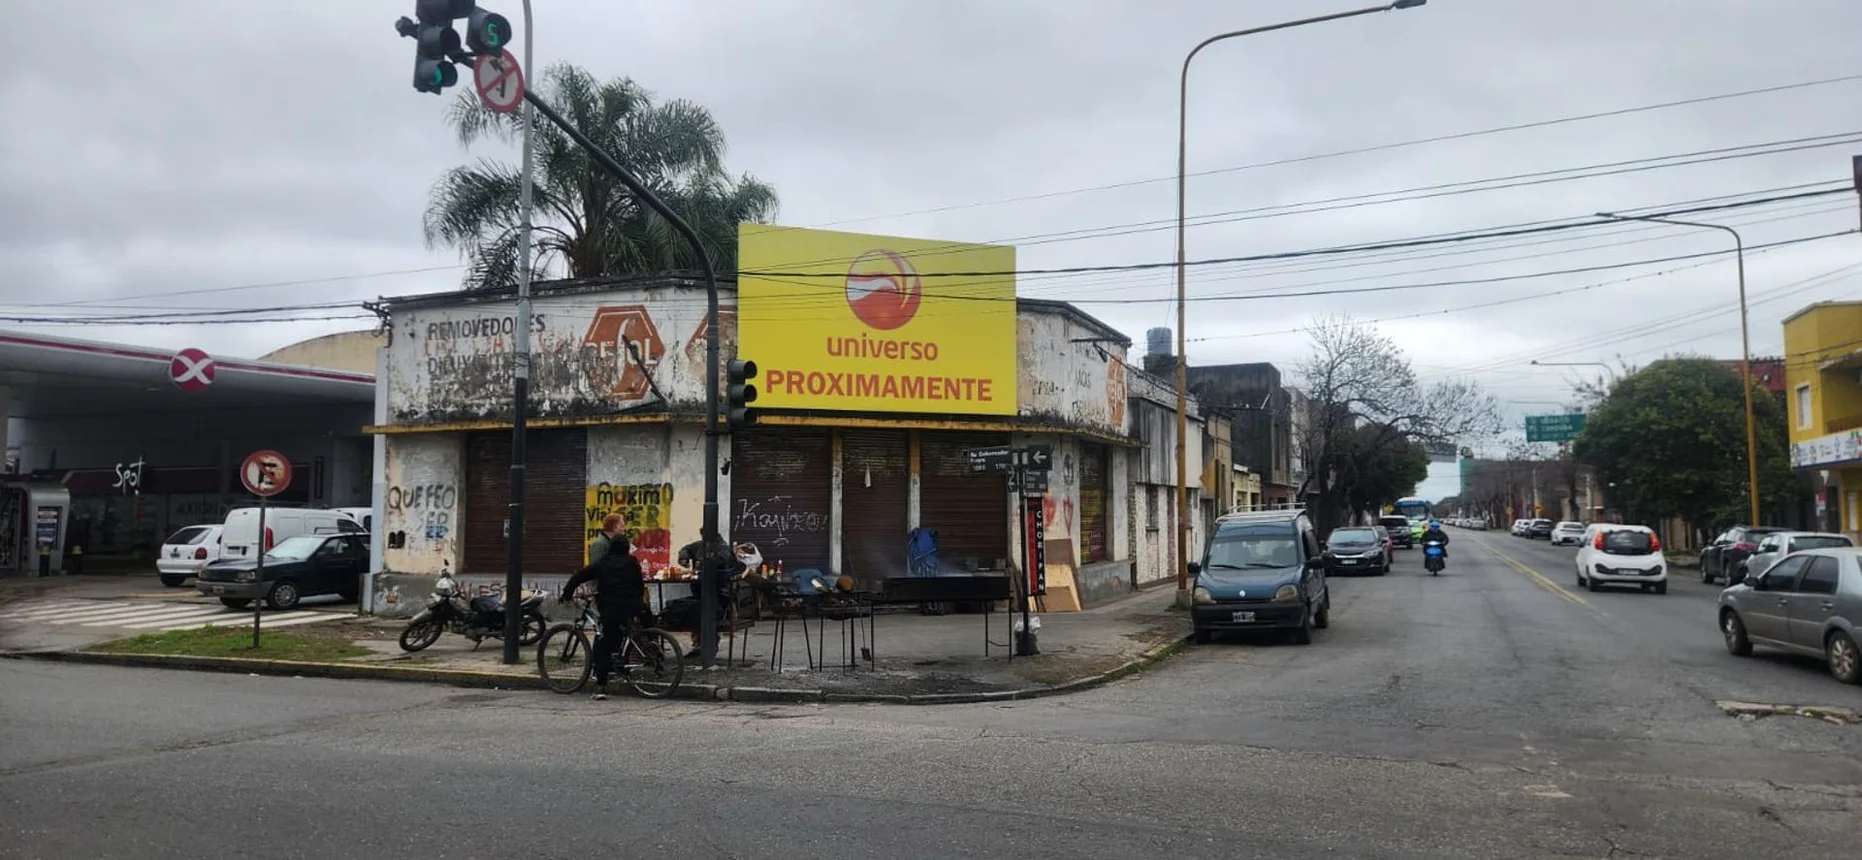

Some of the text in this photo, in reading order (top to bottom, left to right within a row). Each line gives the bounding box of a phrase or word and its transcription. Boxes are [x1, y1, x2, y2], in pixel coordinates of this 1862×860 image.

[427, 313, 547, 341] REMOVEDOES
[826, 332, 939, 361] universo
[765, 369, 993, 402] PROXIMAMENTE
[112, 455, 147, 496] Spot
[387, 484, 457, 512] QUE FEO
[1036, 510, 1044, 591] CHORIPAN
